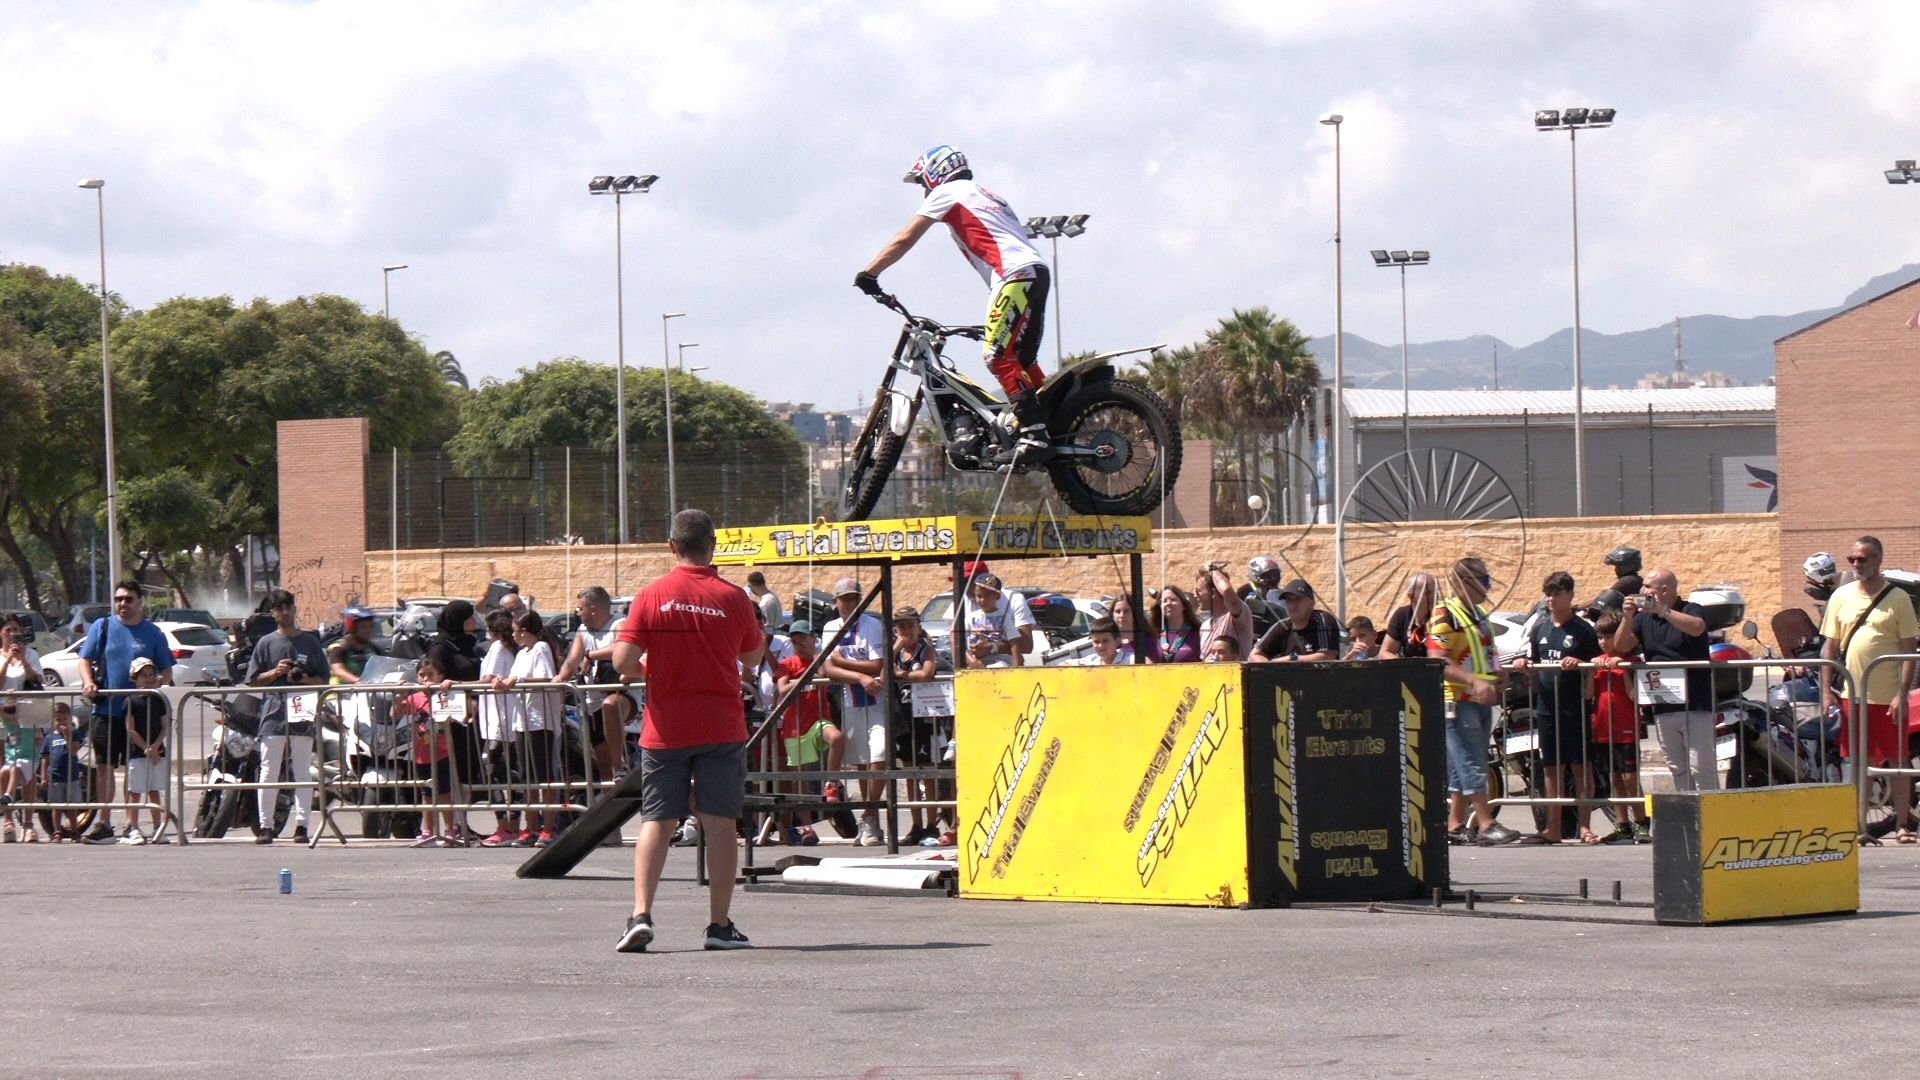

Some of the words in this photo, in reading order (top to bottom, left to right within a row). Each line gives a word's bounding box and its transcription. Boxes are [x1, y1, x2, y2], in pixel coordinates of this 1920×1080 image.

[769, 529, 840, 557] Trial
[845, 524, 955, 555] Events
[972, 521, 1038, 548] Trial
[1042, 521, 1138, 549] Events
[714, 539, 763, 555] vilés
[673, 603, 727, 618] HONDA
[1548, 649, 1561, 659] Fly
[1317, 710, 1371, 730] Trial
[1306, 736, 1386, 757] Events
[967, 682, 1047, 885] Avilés
[1137, 684, 1229, 888] Avilés
[1272, 686, 1298, 890] Avilés
[1401, 681, 1427, 881] Avilés
[1310, 829, 1388, 850] Events
[1702, 827, 1857, 870] Avilés
[1325, 857, 1379, 878] Trial
[1723, 851, 1845, 872] avilesracing.com
